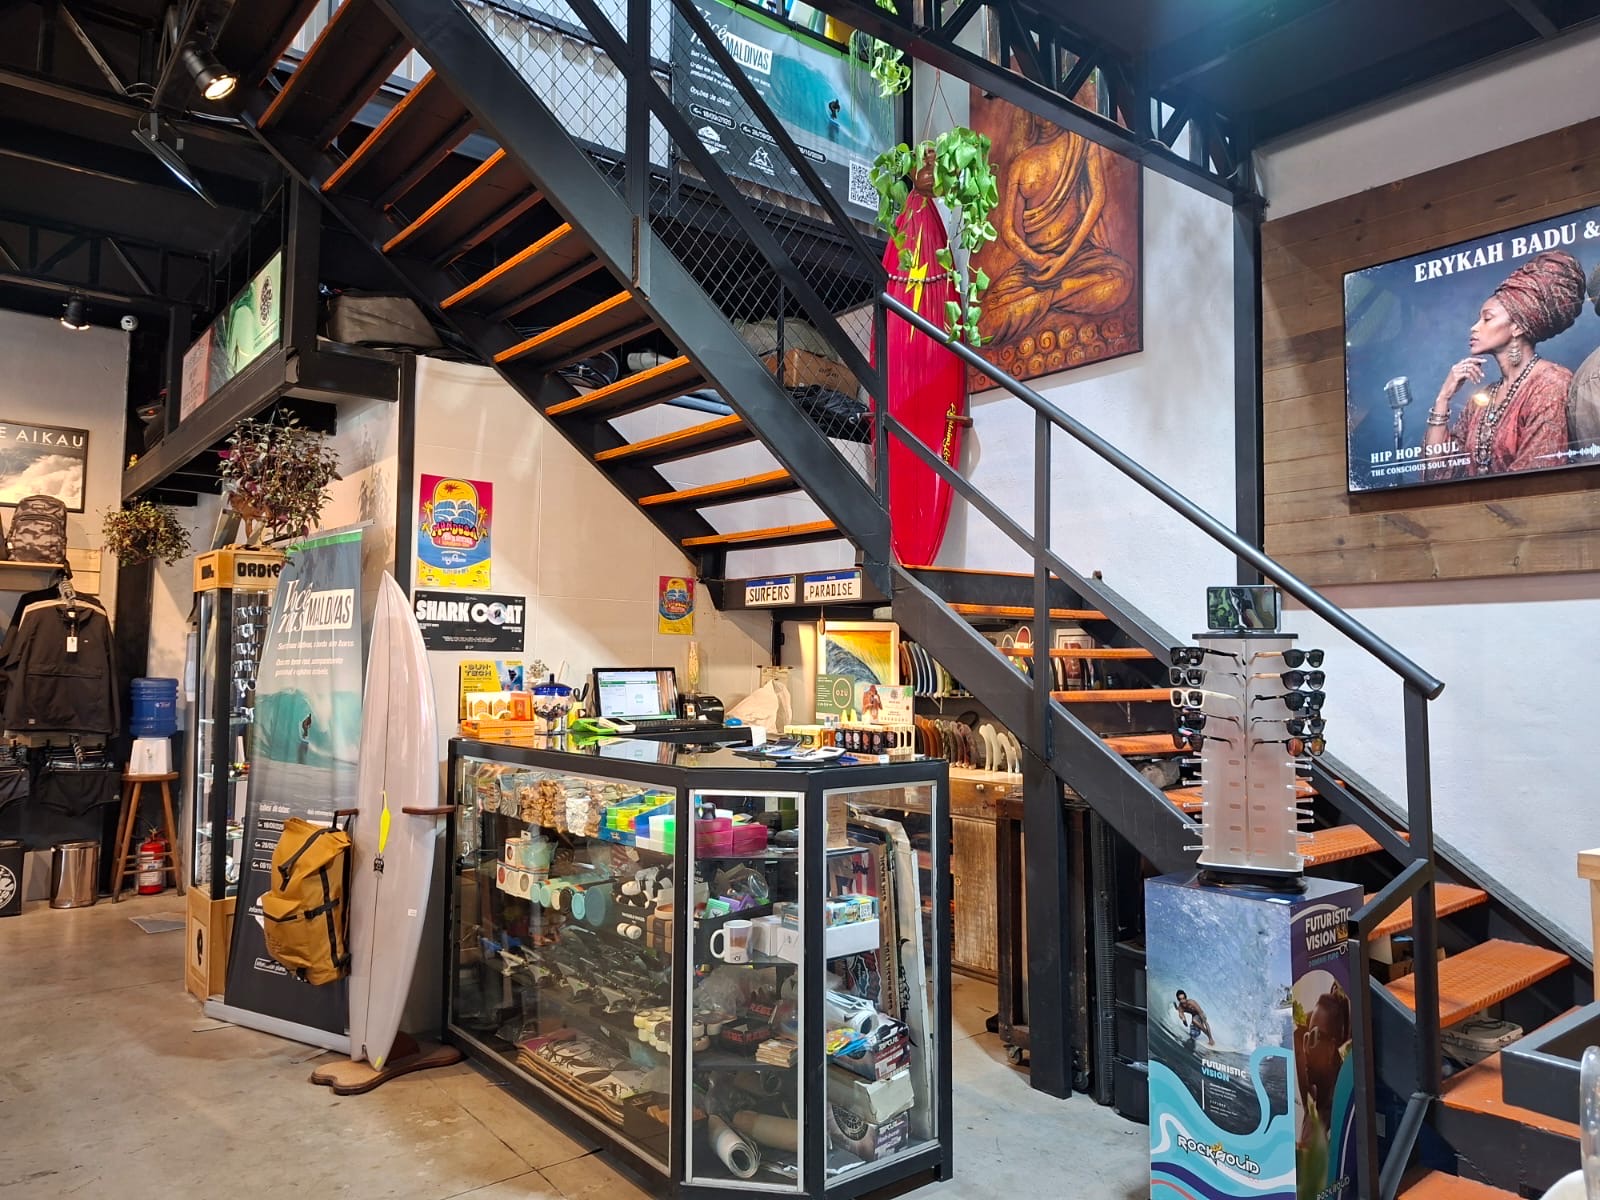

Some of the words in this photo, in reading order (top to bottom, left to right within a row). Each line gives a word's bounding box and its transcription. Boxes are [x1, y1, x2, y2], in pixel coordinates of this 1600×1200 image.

[726, 36, 769, 71] MALDIVAS
[1414, 243, 1503, 283] ERYKAH
[1512, 223, 1577, 258] BADU
[1583, 220, 1600, 240] &
[15, 429, 84, 447] AIKAU
[1371, 450, 1393, 464] HIP
[1396, 446, 1422, 460] HOP
[1425, 441, 1459, 456] SOUL
[1371, 468, 1385, 477] THE
[1386, 464, 1426, 475] CONSCIOUS
[1427, 461, 1446, 470] SOUL
[1448, 457, 1471, 467] TAPES
[749, 585, 790, 602] SURFERS
[809, 582, 853, 598] PARADISE
[306, 595, 352, 627] MALDIVAS
[415, 600, 470, 622] SHARK
[470, 602, 523, 625] COAT
[1305, 907, 1352, 933] FUTURISTIC
[1306, 929, 1337, 951] VISION
[1202, 1059, 1247, 1079] FUTURISTIC
[1202, 1067, 1230, 1082] VISION
